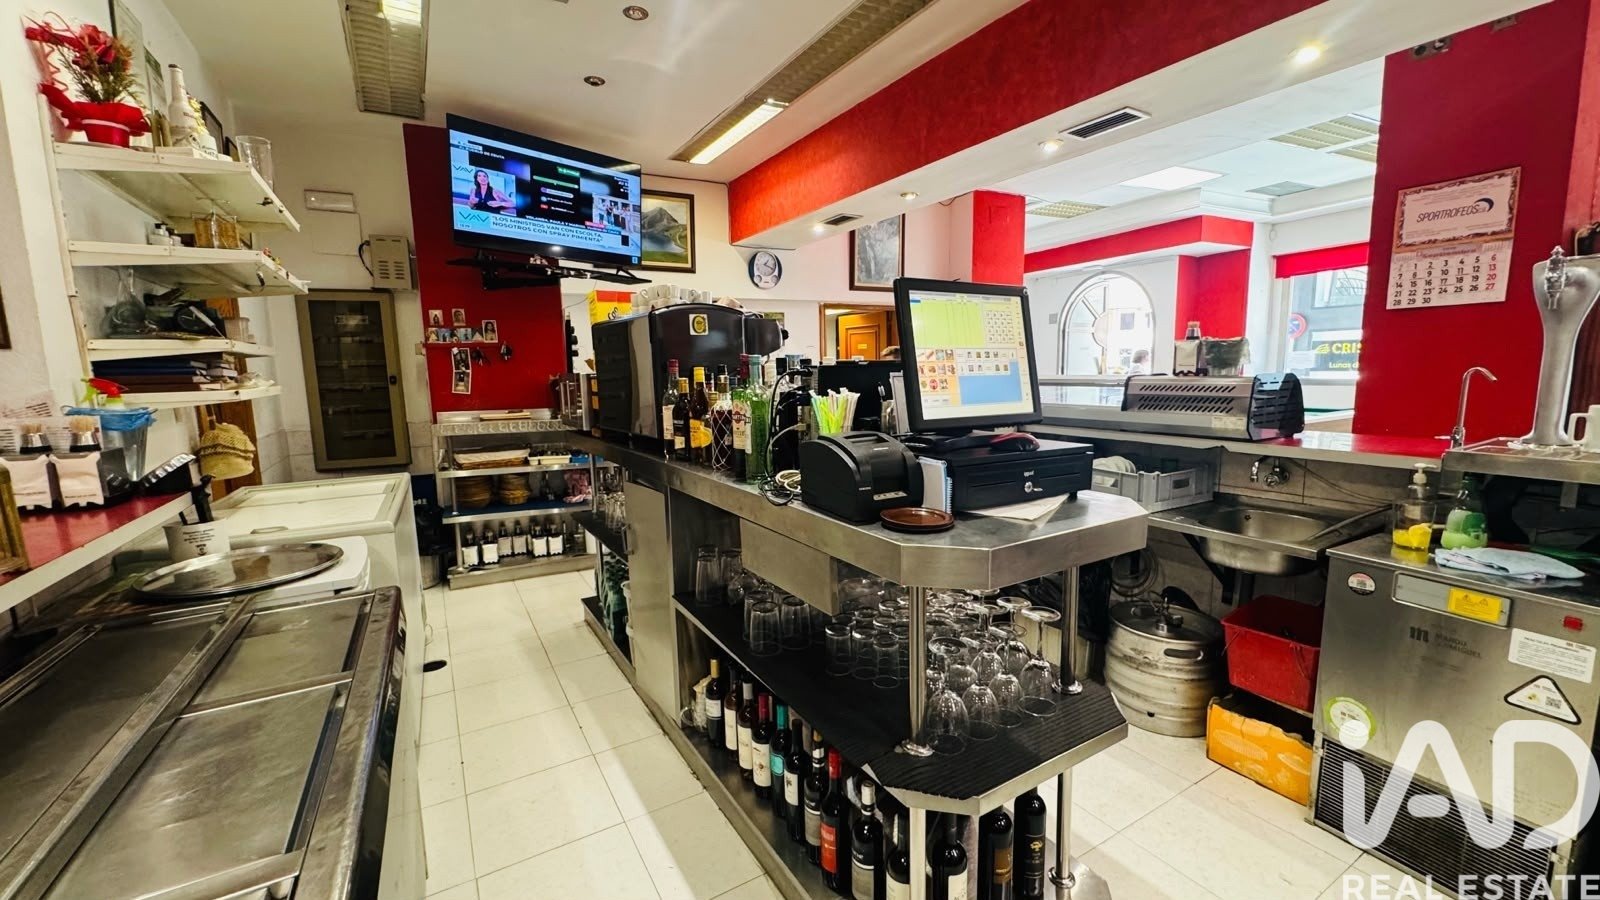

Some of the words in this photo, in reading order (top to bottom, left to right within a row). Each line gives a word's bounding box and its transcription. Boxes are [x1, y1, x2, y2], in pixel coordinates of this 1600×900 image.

[510, 217, 546, 229] MINISTROS
[492, 221, 532, 232] NOSOTROS
[549, 230, 570, 238] SPRAY
[1487, 273, 1496, 281] 20
